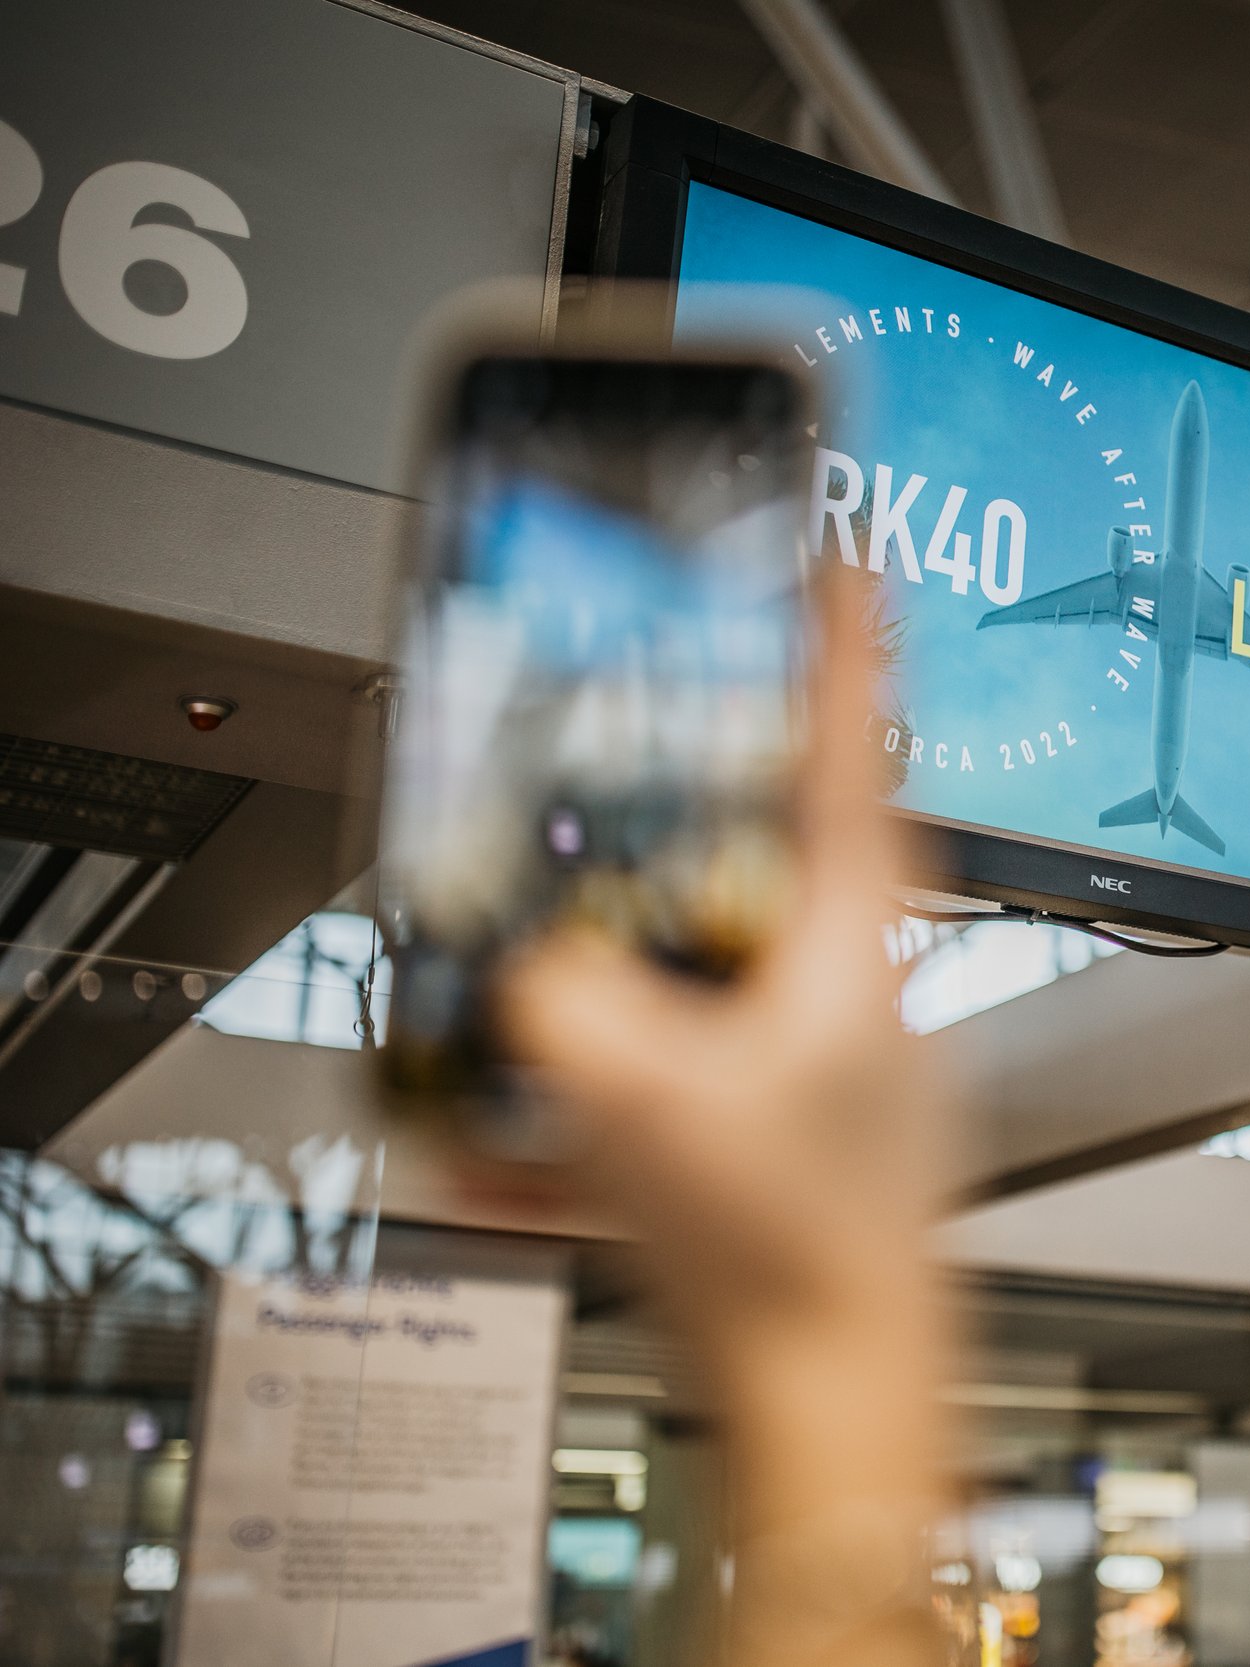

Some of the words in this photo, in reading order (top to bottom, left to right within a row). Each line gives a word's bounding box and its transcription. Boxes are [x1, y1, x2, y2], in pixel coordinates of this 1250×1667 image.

[794, 306, 961, 367] LEMENTS
[1013, 341, 1097, 425] WAVE
[807, 446, 1027, 606] RK40
[1101, 448, 1155, 567] AFTER
[1107, 596, 1155, 692] WAVE
[1000, 720, 1077, 770] 2022
[1090, 874, 1132, 894] NEC
